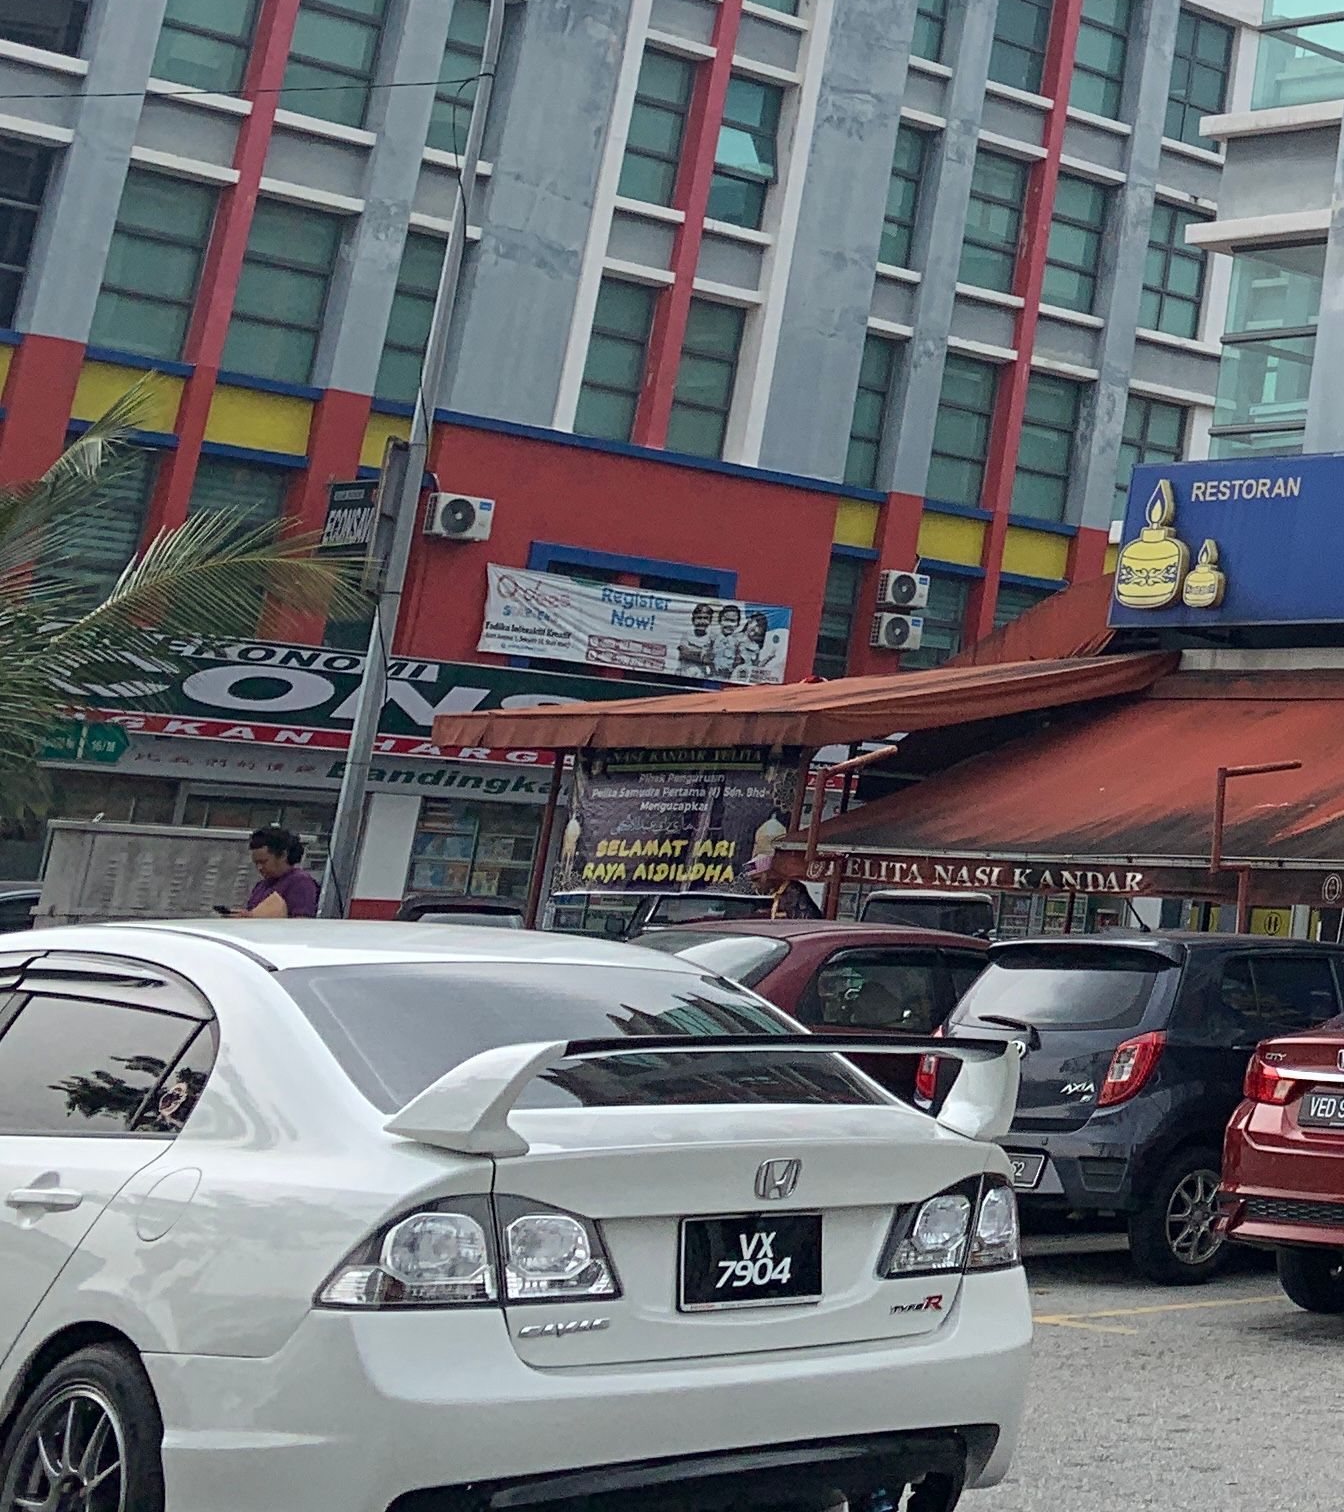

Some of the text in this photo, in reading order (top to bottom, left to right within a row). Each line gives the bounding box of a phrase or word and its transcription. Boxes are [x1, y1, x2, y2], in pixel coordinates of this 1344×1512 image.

[1190, 476, 1301, 503] RESTORAN
[600, 587, 673, 611] Register
[610, 609, 656, 631] Now!
[103, 714, 313, 745] GKAN
[639, 800, 709, 813] Mengucapka
[595, 838, 689, 858] SELAMAT
[581, 862, 627, 884] RAYA
[934, 863, 1002, 888] NASI
[1012, 866, 1145, 893] KANDAR
[1310, 1096, 1337, 1118] VED
[739, 1231, 777, 1260] VX
[714, 1256, 793, 1290] 7904
[517, 1317, 611, 1339] CIVIC
